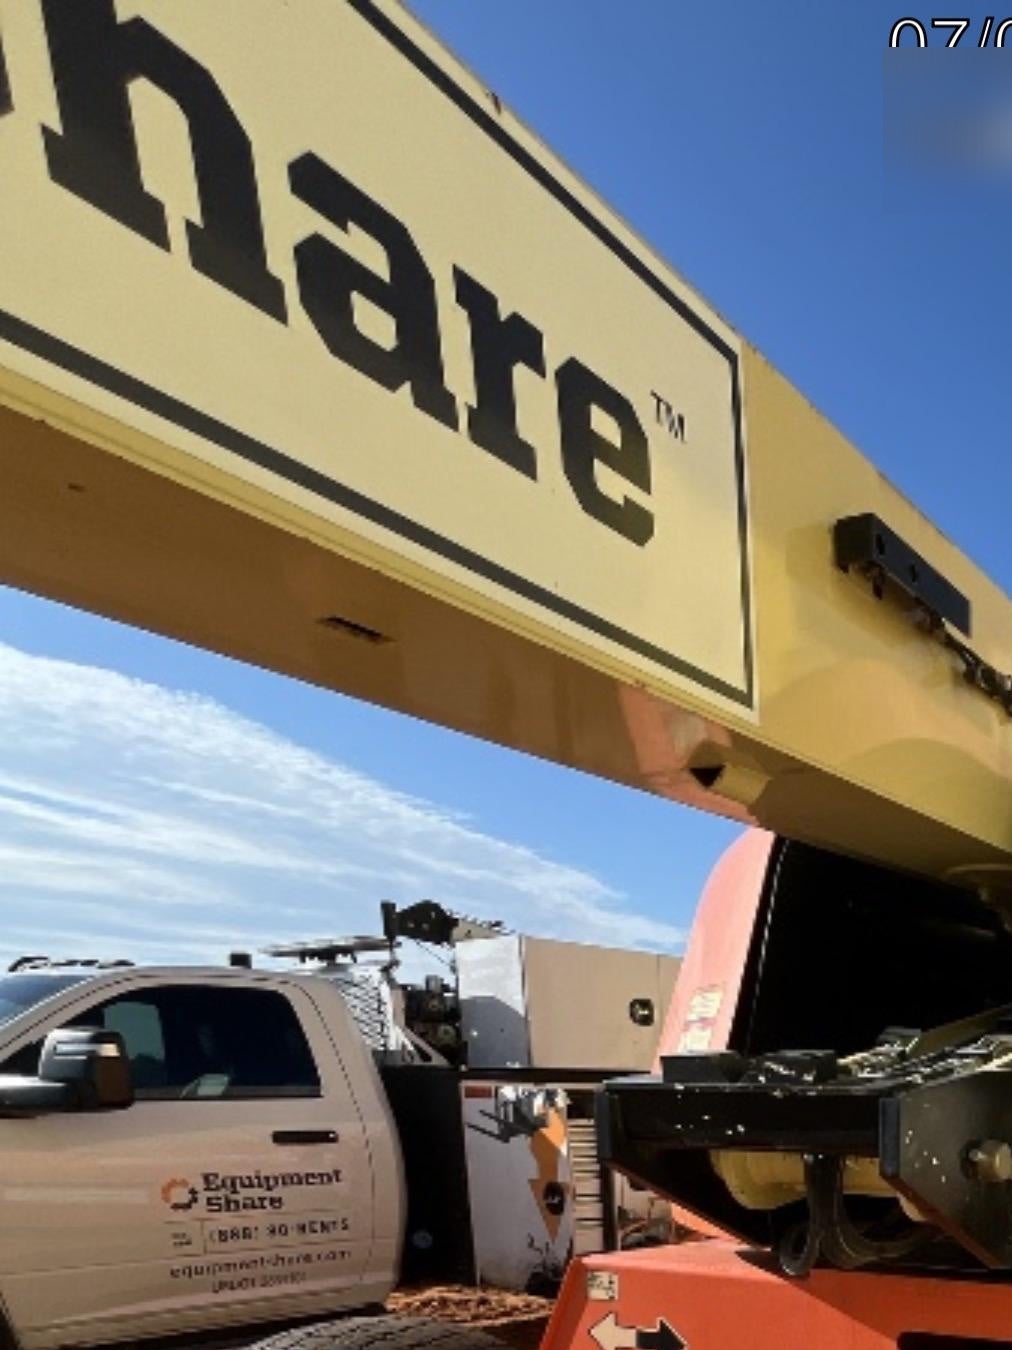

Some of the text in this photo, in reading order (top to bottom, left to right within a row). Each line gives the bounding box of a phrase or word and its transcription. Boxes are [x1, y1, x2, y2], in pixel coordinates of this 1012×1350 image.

[0, 0, 656, 547] hare
[202, 1168, 343, 1195] Equipment
[205, 1194, 284, 1213] Share
